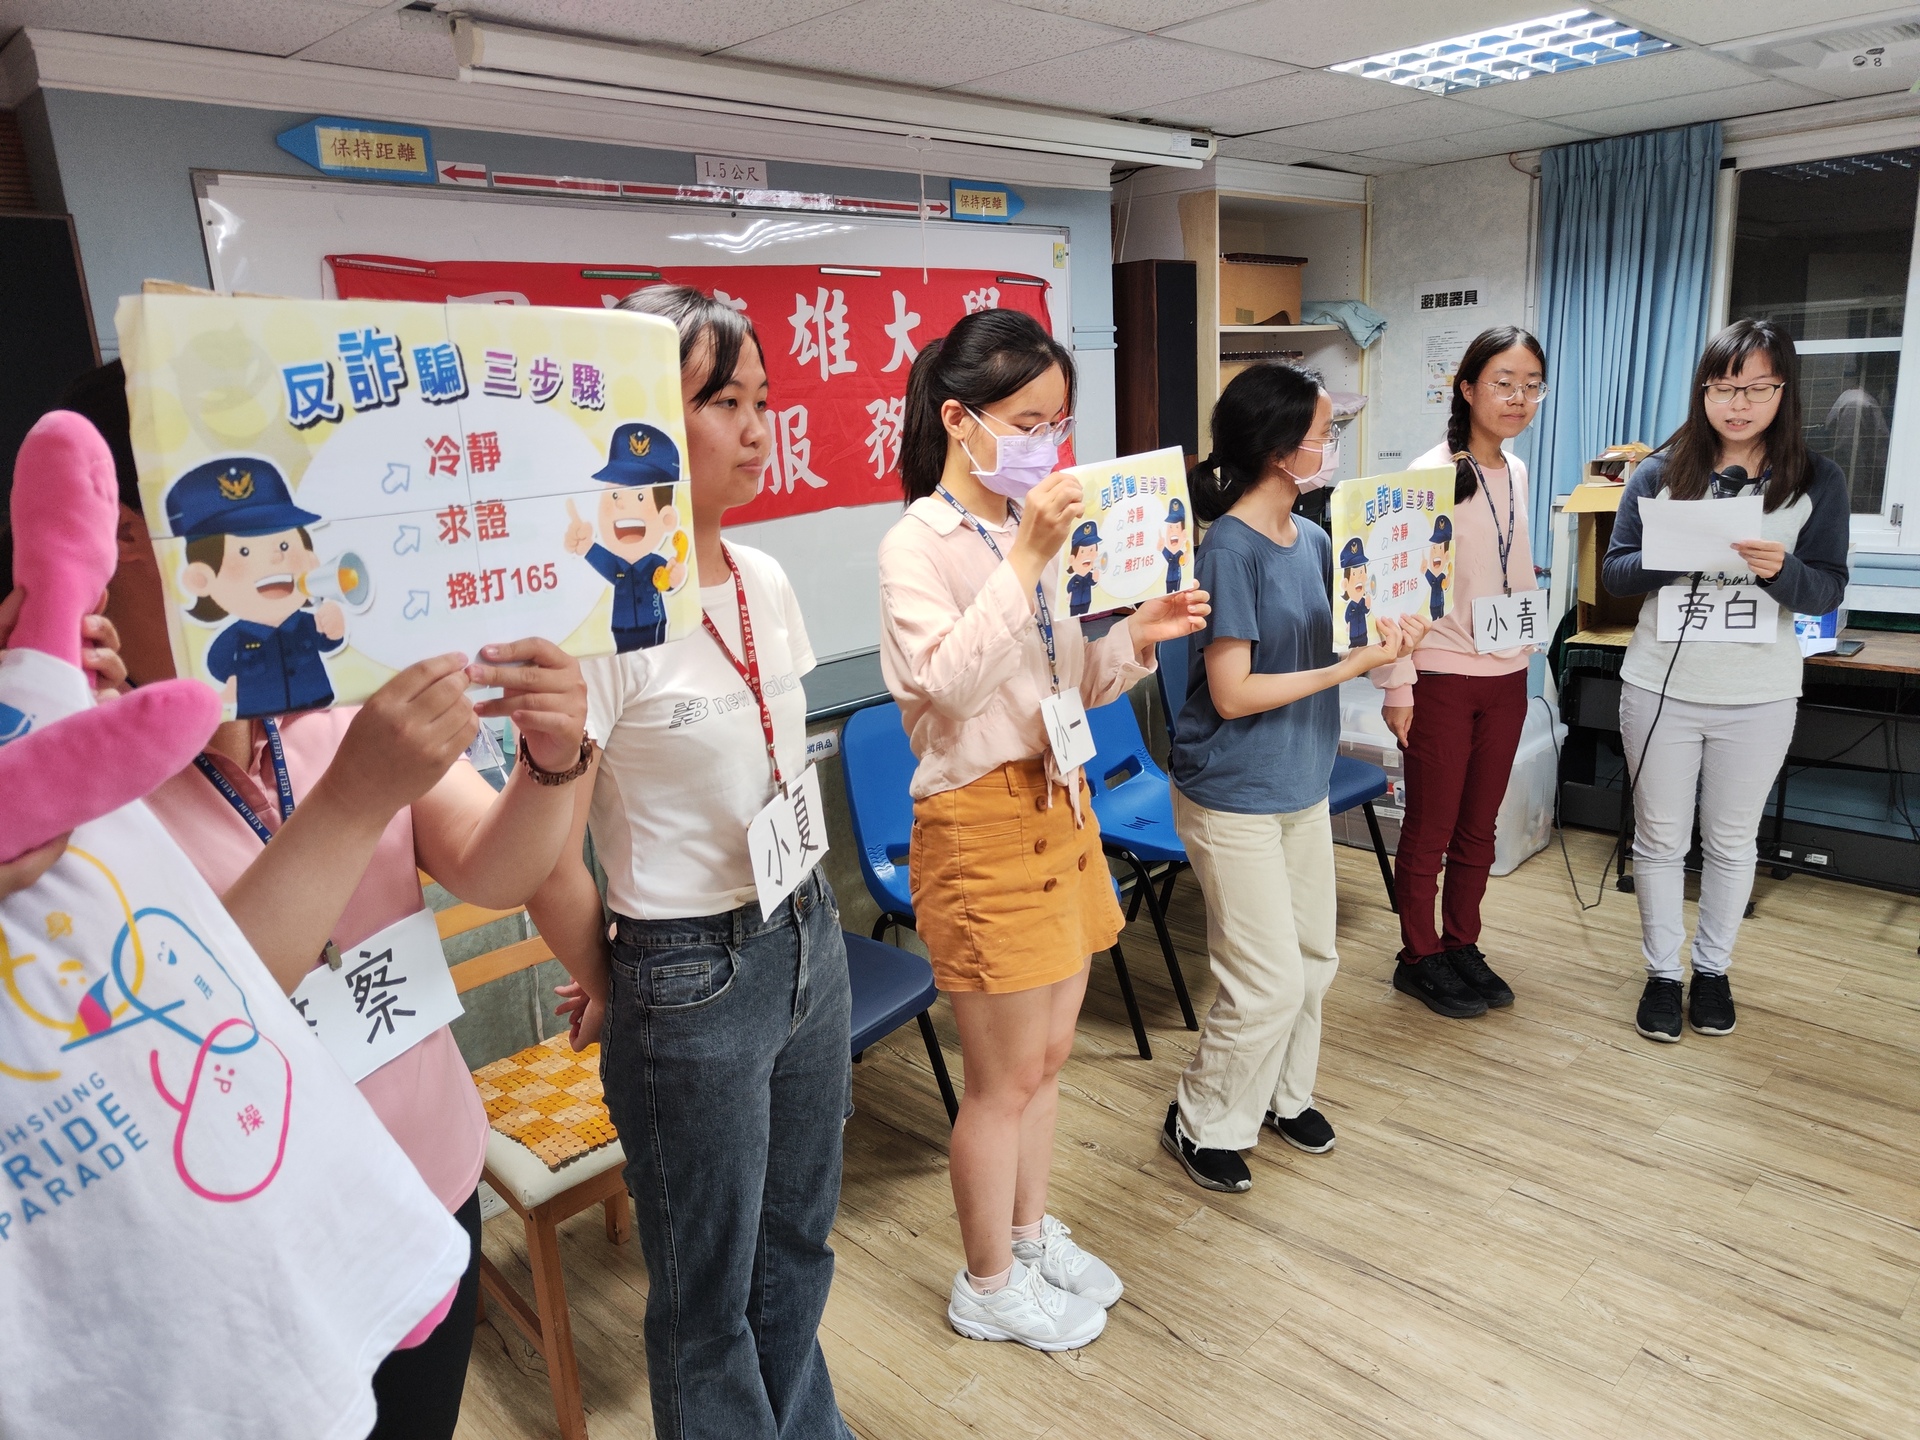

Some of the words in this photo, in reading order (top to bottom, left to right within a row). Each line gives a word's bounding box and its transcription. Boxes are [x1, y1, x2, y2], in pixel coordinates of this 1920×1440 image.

[330, 136, 417, 162] 保持距離
[704, 160, 760, 183] 1.5公尺
[959, 194, 1003, 210] 保持距離
[1420, 290, 1478, 310] 避難器具
[281, 326, 606, 425] 反詐騙三步驟
[424, 431, 502, 478] 冷靜
[436, 499, 510, 545] 求證
[446, 562, 558, 610] 撥打165
[1487, 597, 1537, 642] 小青
[1677, 590, 1757, 631] 旁白
[748, 649, 757, 664] NUK
[712, 689, 750, 714] new
[1052, 704, 1082, 762] 小一
[766, 784, 819, 887] 小夏
[237, 1104, 264, 1136] 操
[0, 1124, 148, 1240] PARADE
